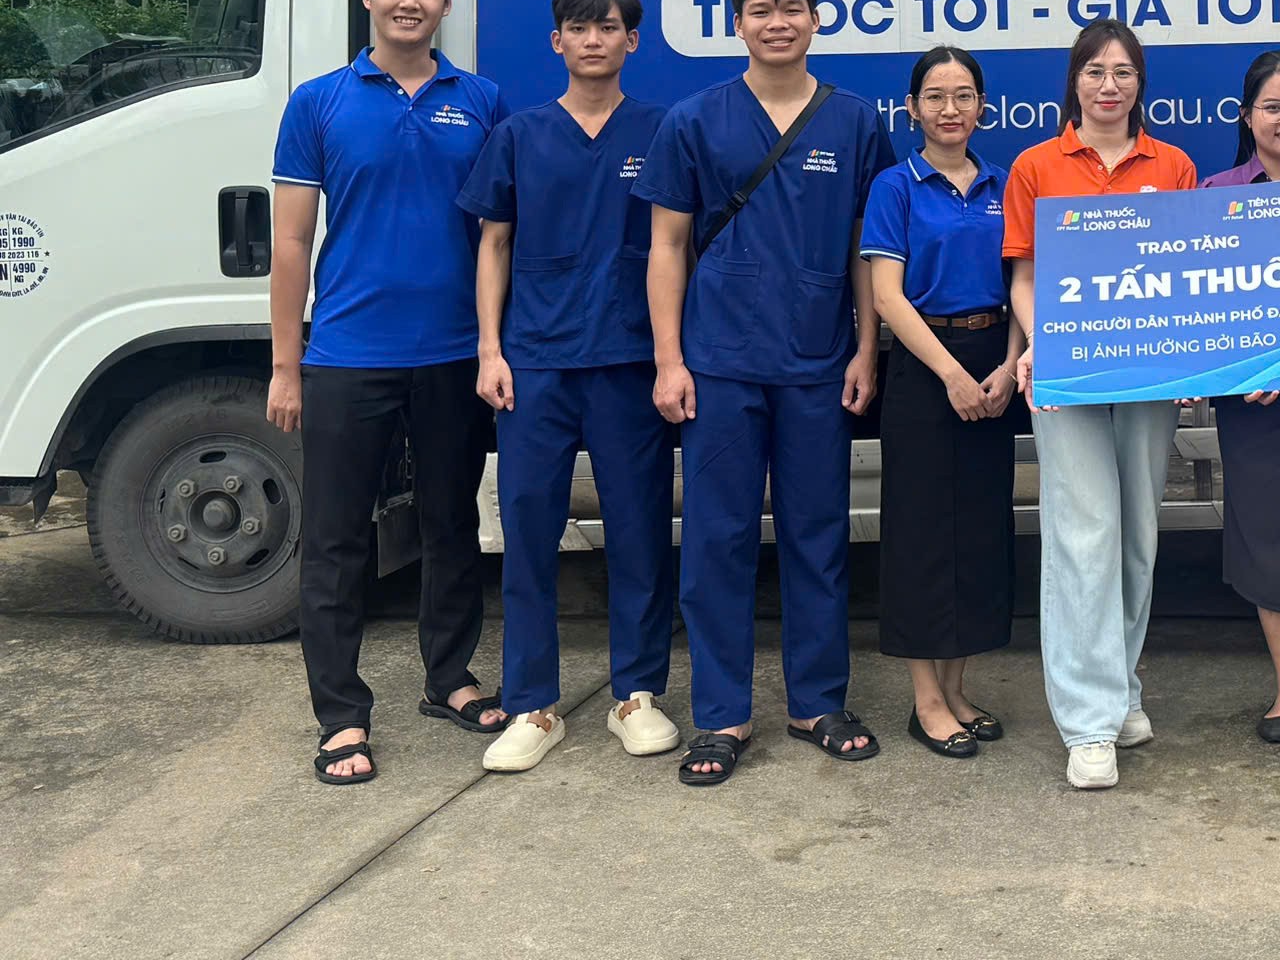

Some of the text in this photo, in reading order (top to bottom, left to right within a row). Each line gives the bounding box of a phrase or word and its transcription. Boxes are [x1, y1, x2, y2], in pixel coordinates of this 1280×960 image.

[1247, 196, 1269, 208] TIÊM
[1083, 206, 1137, 219] NHÀ THUỐC
[1083, 216, 1151, 232] LONG CHÂU
[12, 227, 23, 236] KG
[12, 236, 35, 248] 1990
[1136, 234, 1240, 255] TRAO TẶNG
[8, 251, 25, 259] 2023
[13, 262, 36, 274] 4990
[1059, 276, 1082, 303] 2
[1091, 263, 1172, 301] TẤN
[1043, 321, 1078, 334] CHO
[1081, 316, 1131, 332] NGƯỜI
[1136, 314, 1170, 329] DÂN
[1172, 311, 1227, 327] THÀNH
[1230, 305, 1264, 322] PHỐ
[1072, 346, 1088, 362] BỊ
[1093, 342, 1131, 359] ẢNH
[1136, 338, 1200, 356] HƯỞNG
[1205, 334, 1235, 352] BỞI
[1240, 331, 1277, 349] BÃO
